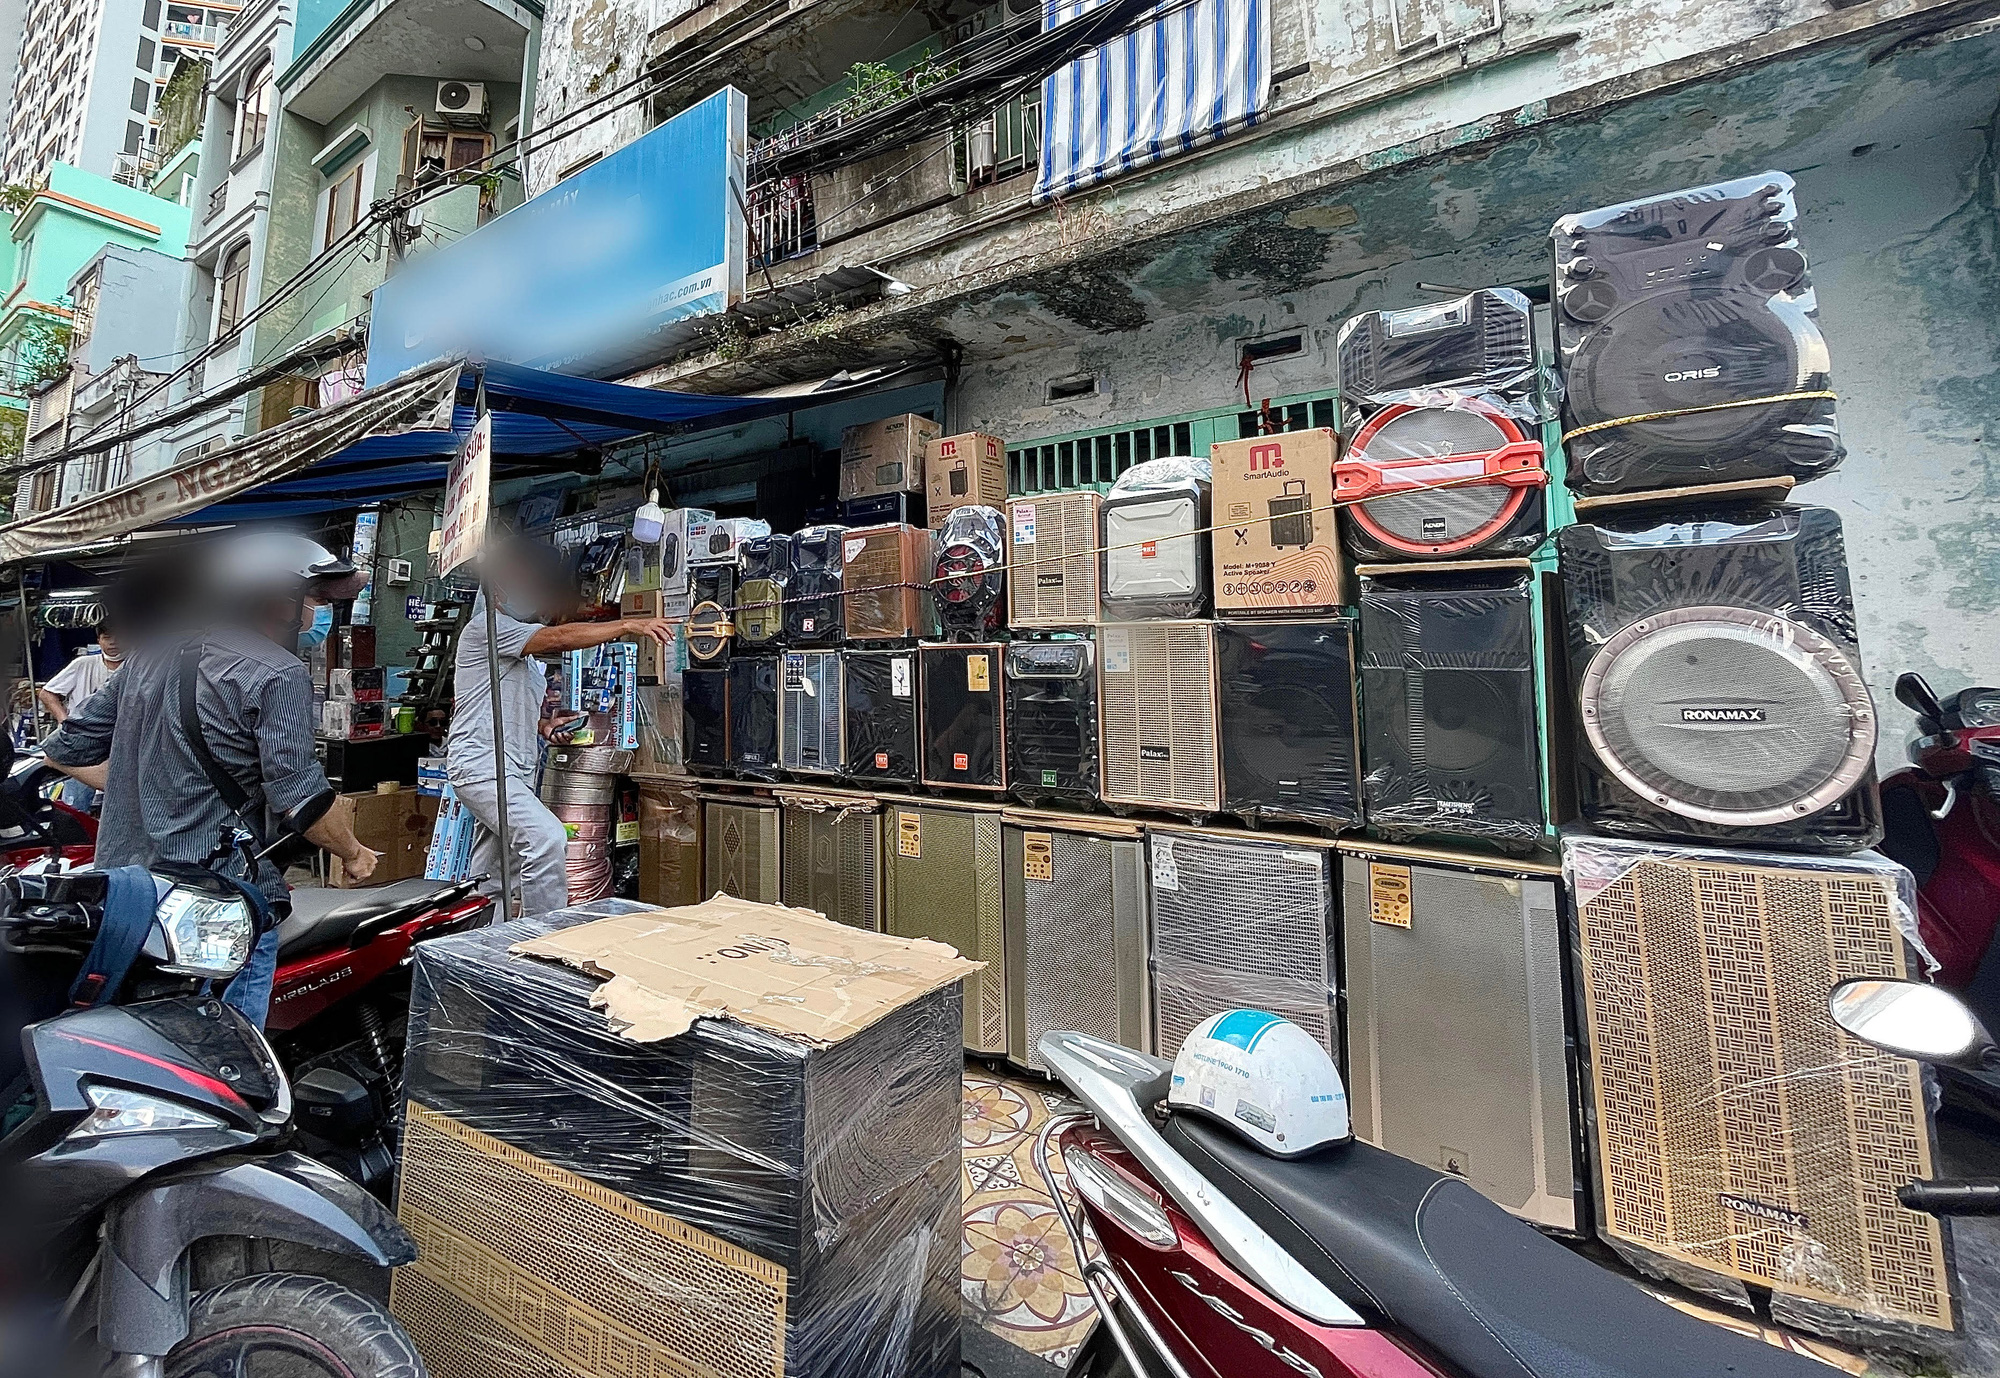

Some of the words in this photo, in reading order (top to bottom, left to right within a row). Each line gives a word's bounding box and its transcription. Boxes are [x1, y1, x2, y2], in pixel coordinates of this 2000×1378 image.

[1664, 365, 1721, 382] ORIS
[1243, 470, 1290, 481] SmartAudio
[1683, 709, 1761, 721] RONAMAX
[1141, 749, 1160, 758] Palax
[1194, 1053, 1217, 1066] HOTLINE
[1217, 1060, 1233, 1072] 1900
[1234, 1066, 1250, 1079] 1710
[1721, 1196, 1802, 1227] RONAMAX
